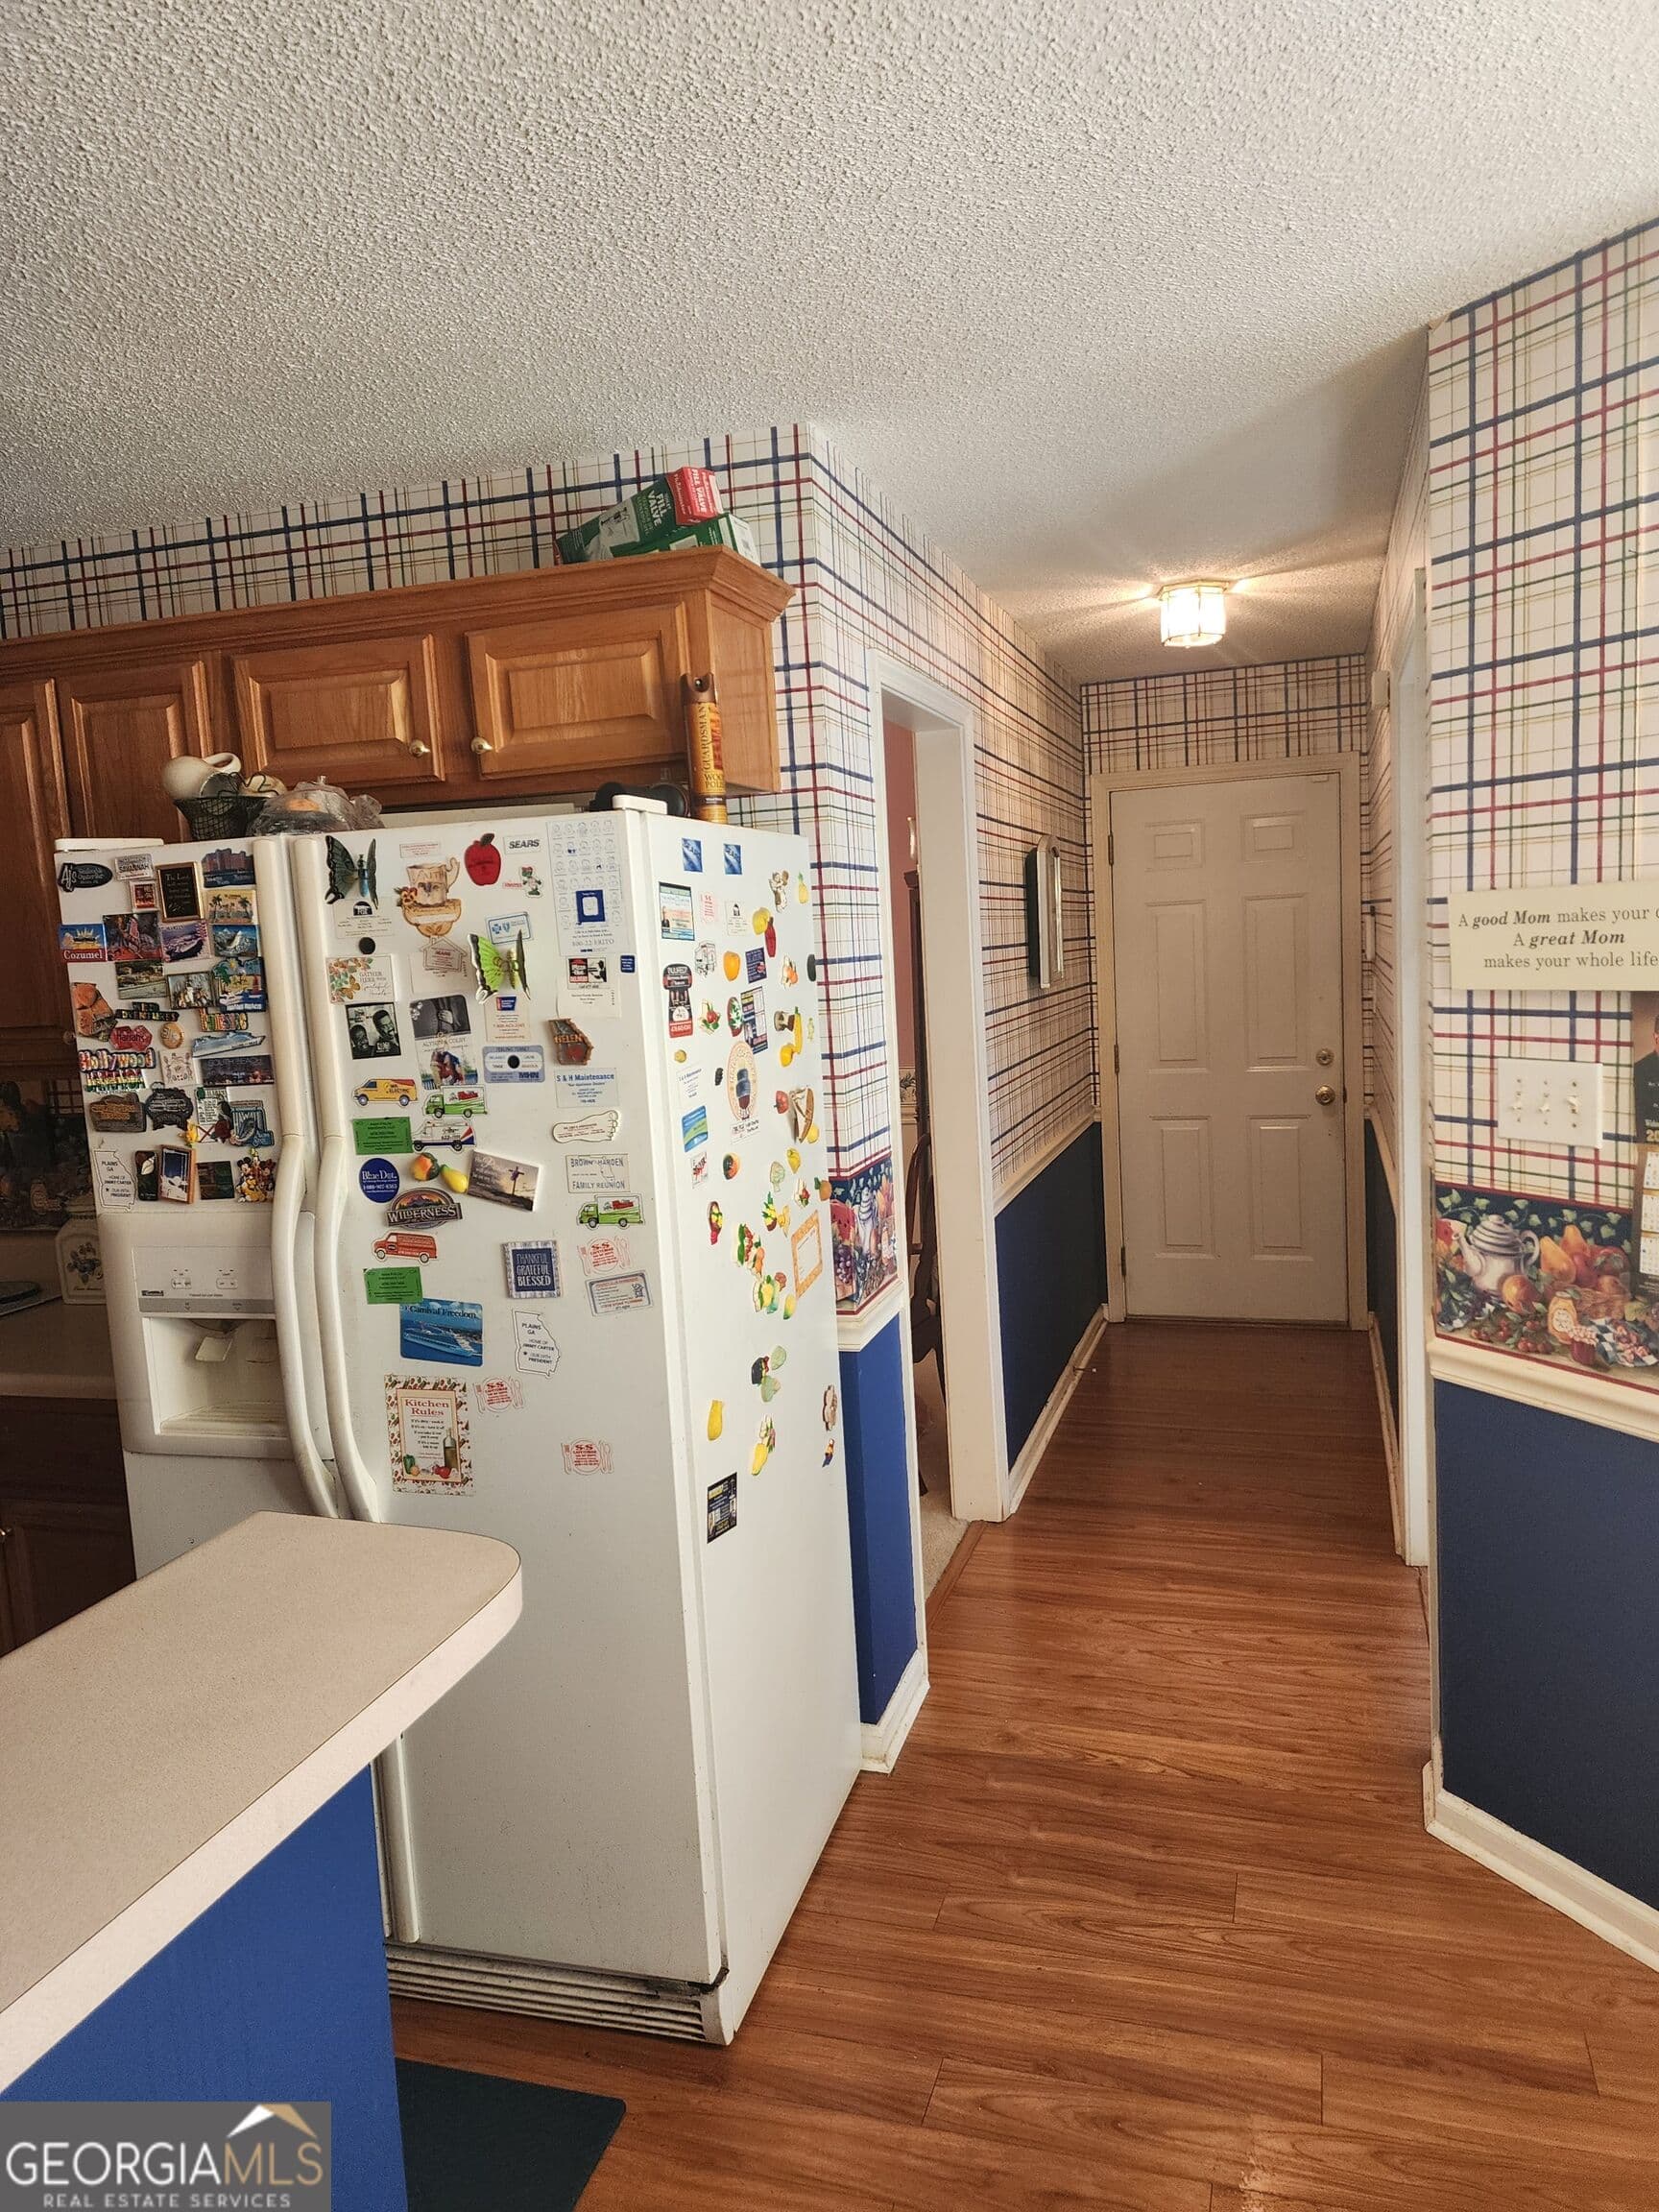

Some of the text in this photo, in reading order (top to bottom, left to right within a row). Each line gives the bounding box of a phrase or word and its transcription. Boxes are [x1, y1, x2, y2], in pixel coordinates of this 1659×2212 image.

[691, 469, 708, 513] FILL VALVE
[648, 490, 661, 527] VALVE
[656, 493, 667, 517] FILL
[698, 706, 712, 770] GUARDSMAN
[509, 839, 540, 850] SEARS
[1458, 907, 1650, 929] A good Mom makes your
[1513, 929, 1625, 950] A great Mom
[63, 949, 104, 960] Cozumel
[1483, 953, 1530, 968] makes
[1535, 955, 1571, 972] your
[1576, 951, 1624, 967] whole
[554, 1034, 584, 1044] HELEN
[78, 1047, 154, 1071] Hollywood
[572, 1181, 625, 1190] FAMILY REUNION
[387, 1205, 456, 1222] WILDERNESS
[517, 1253, 549, 1264] THANKFUL
[517, 1264, 550, 1275] GRATEFUL
[517, 1275, 551, 1286] BLESSED
[410, 1306, 477, 1319] Carnival Freedom
[405, 1399, 449, 1407] Kitchen
[411, 1407, 445, 1416] Rules
